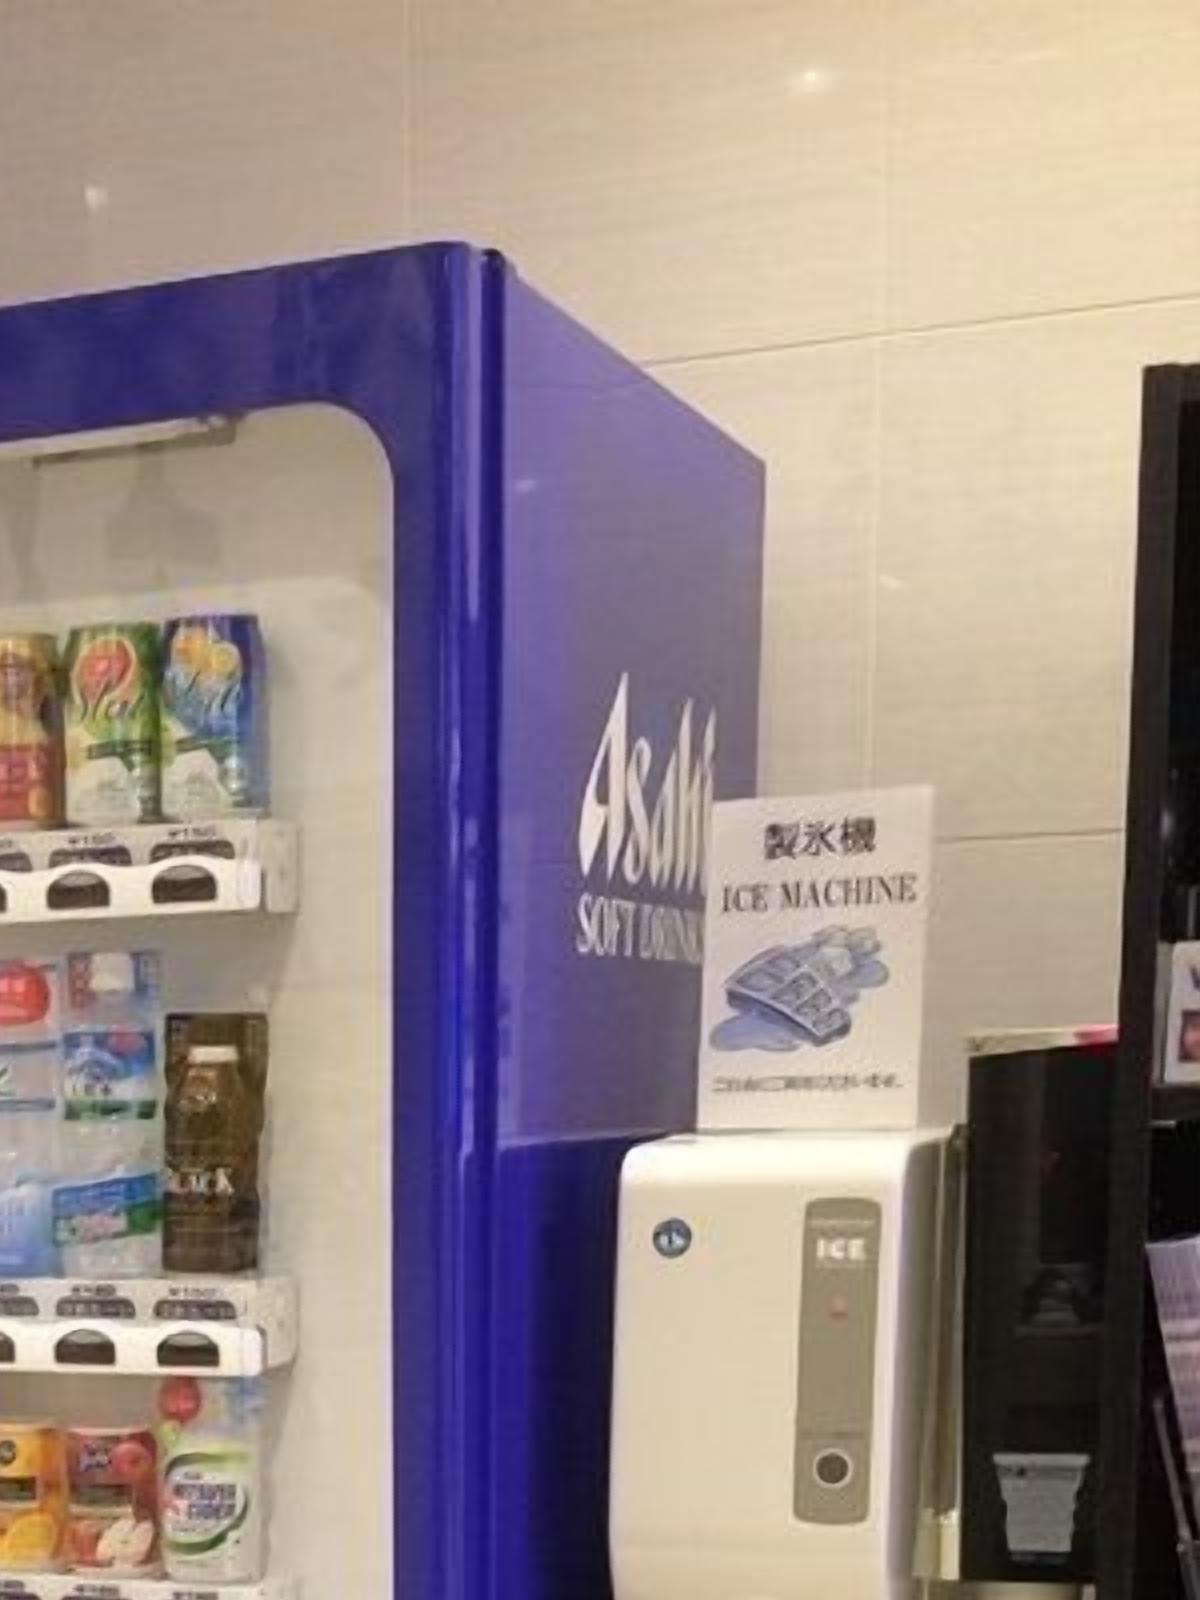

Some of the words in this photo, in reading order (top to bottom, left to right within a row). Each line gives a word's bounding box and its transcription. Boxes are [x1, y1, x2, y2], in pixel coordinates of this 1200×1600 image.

[578, 671, 717, 895] Asahi
[765, 817, 876, 861] 製氷機
[722, 884, 769, 913] ICE
[780, 873, 919, 910] MACHINE
[576, 891, 637, 957] SOFT
[816, 1237, 867, 1261] ICE
